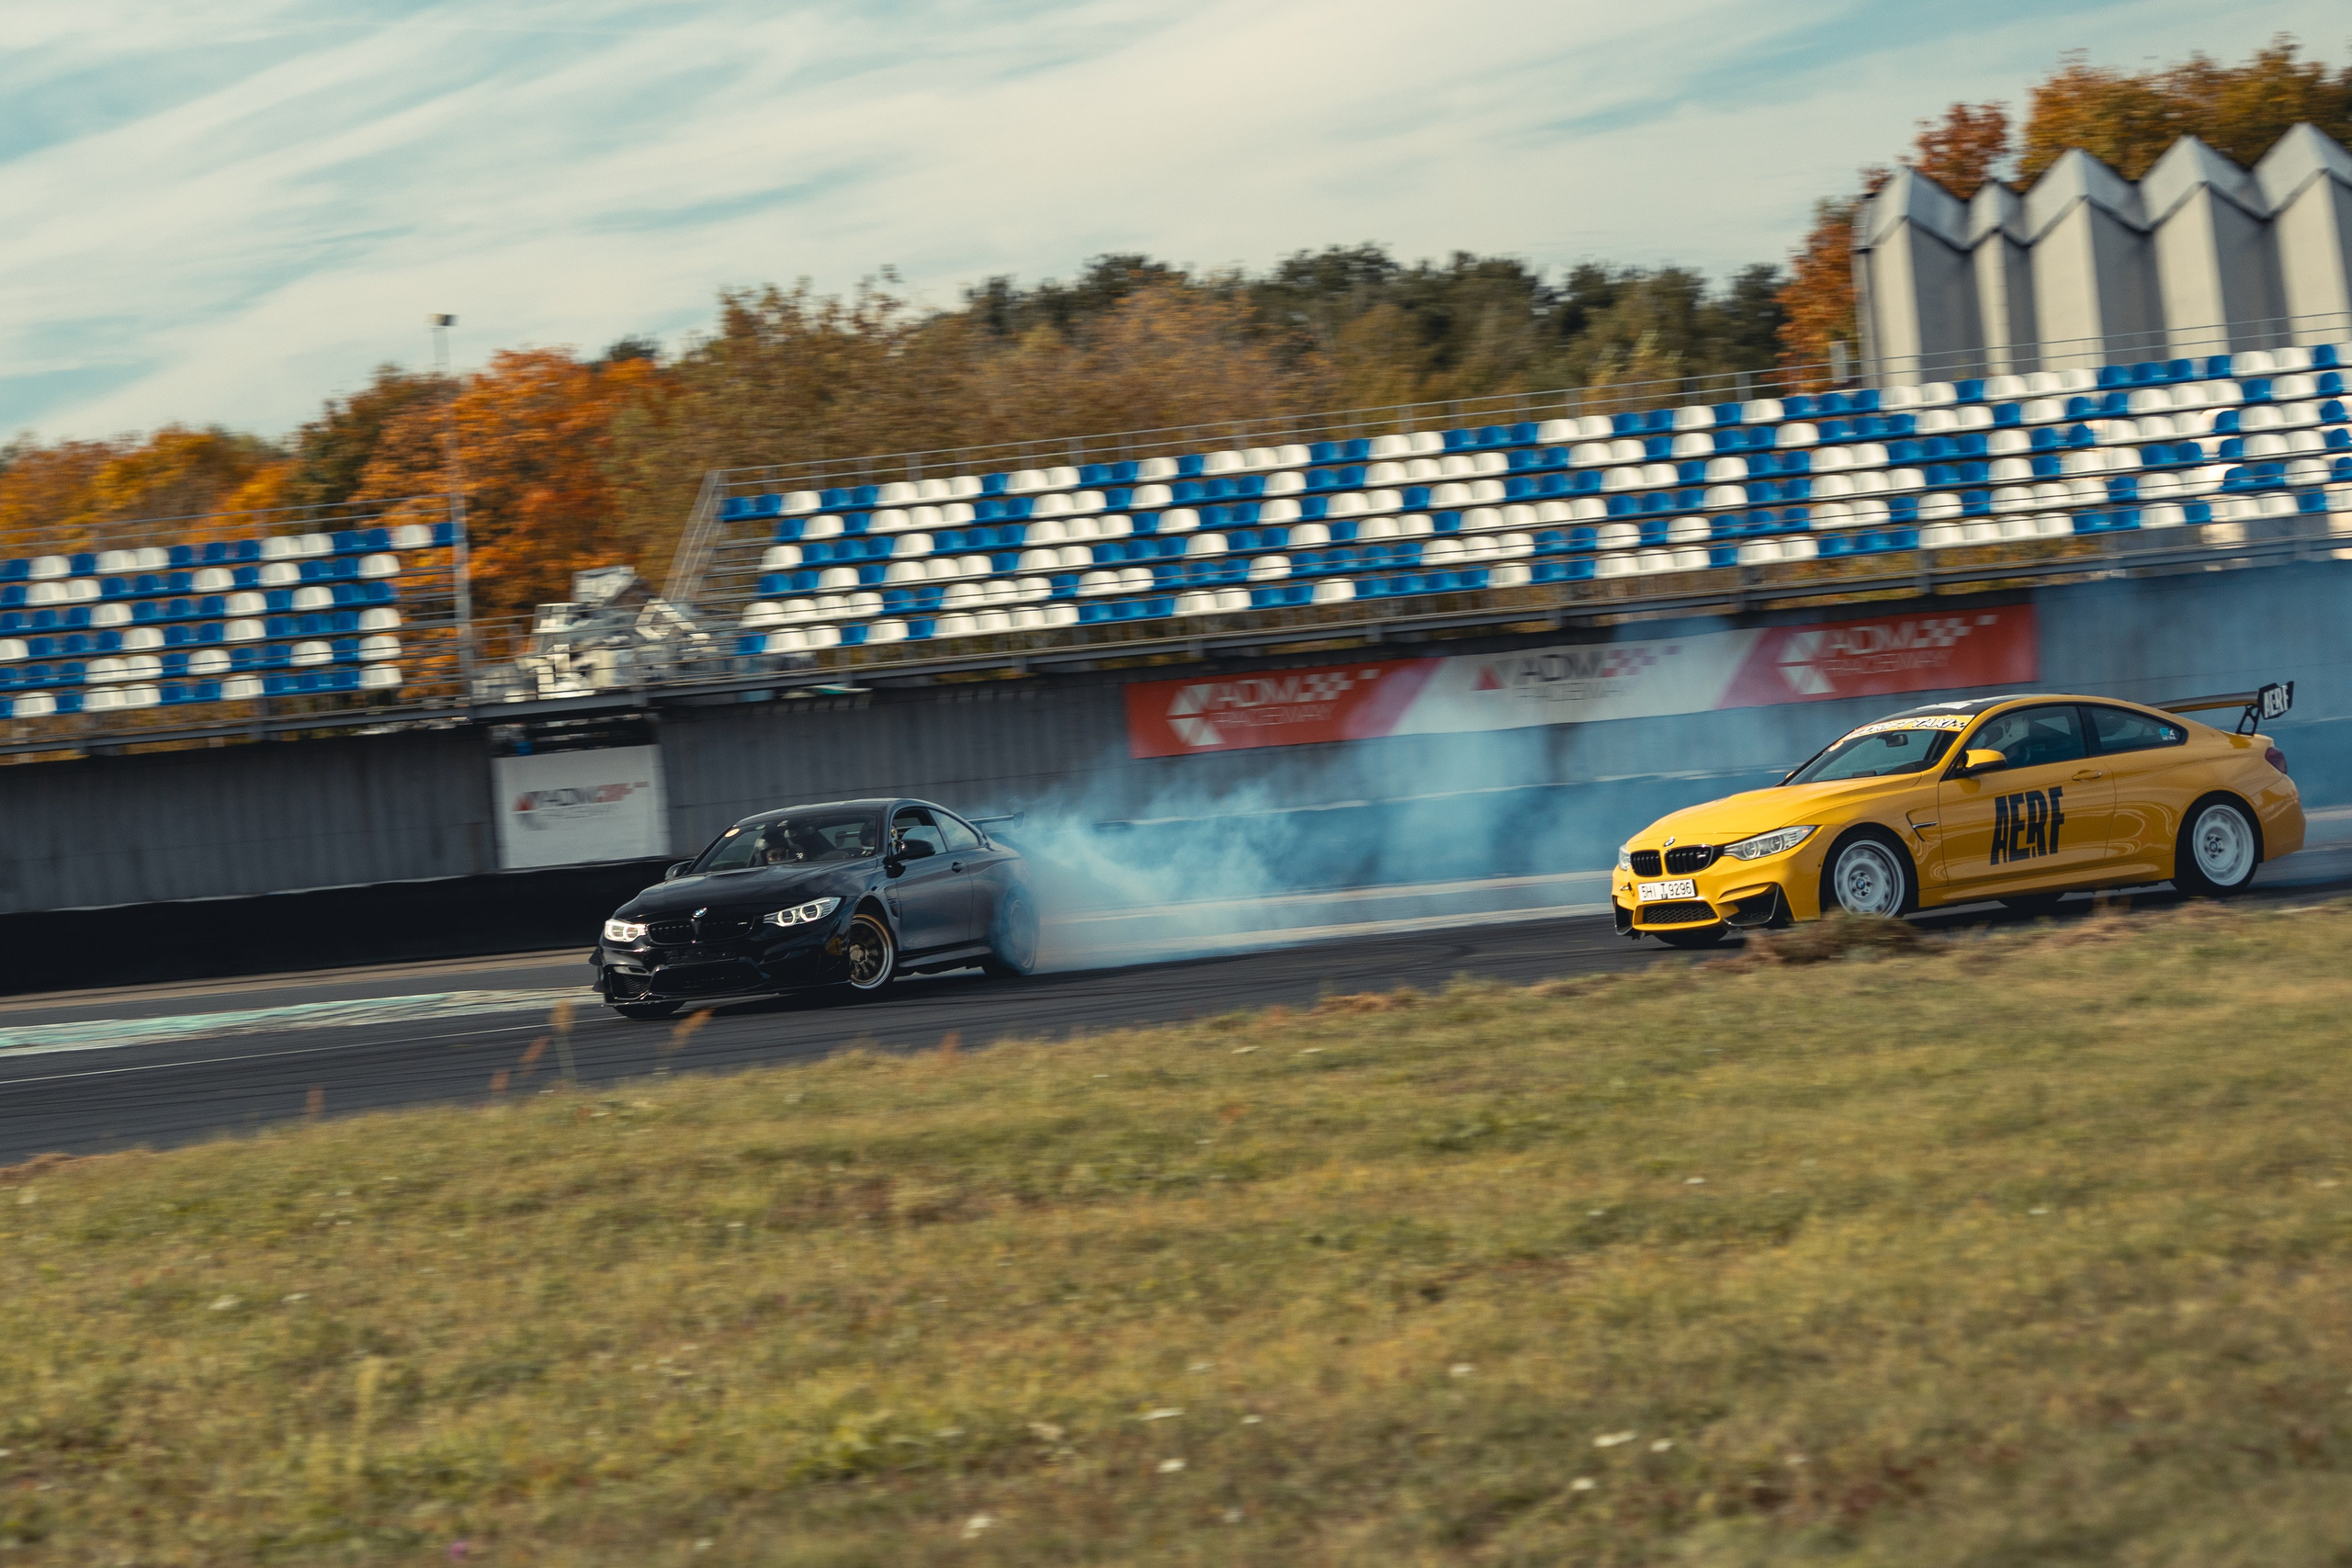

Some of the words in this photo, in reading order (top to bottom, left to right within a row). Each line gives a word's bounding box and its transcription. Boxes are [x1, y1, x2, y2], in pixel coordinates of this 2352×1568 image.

[2263, 684, 2290, 718] AERF
[1990, 786, 2065, 865] AERF
[1668, 882, 1692, 897] 9296
